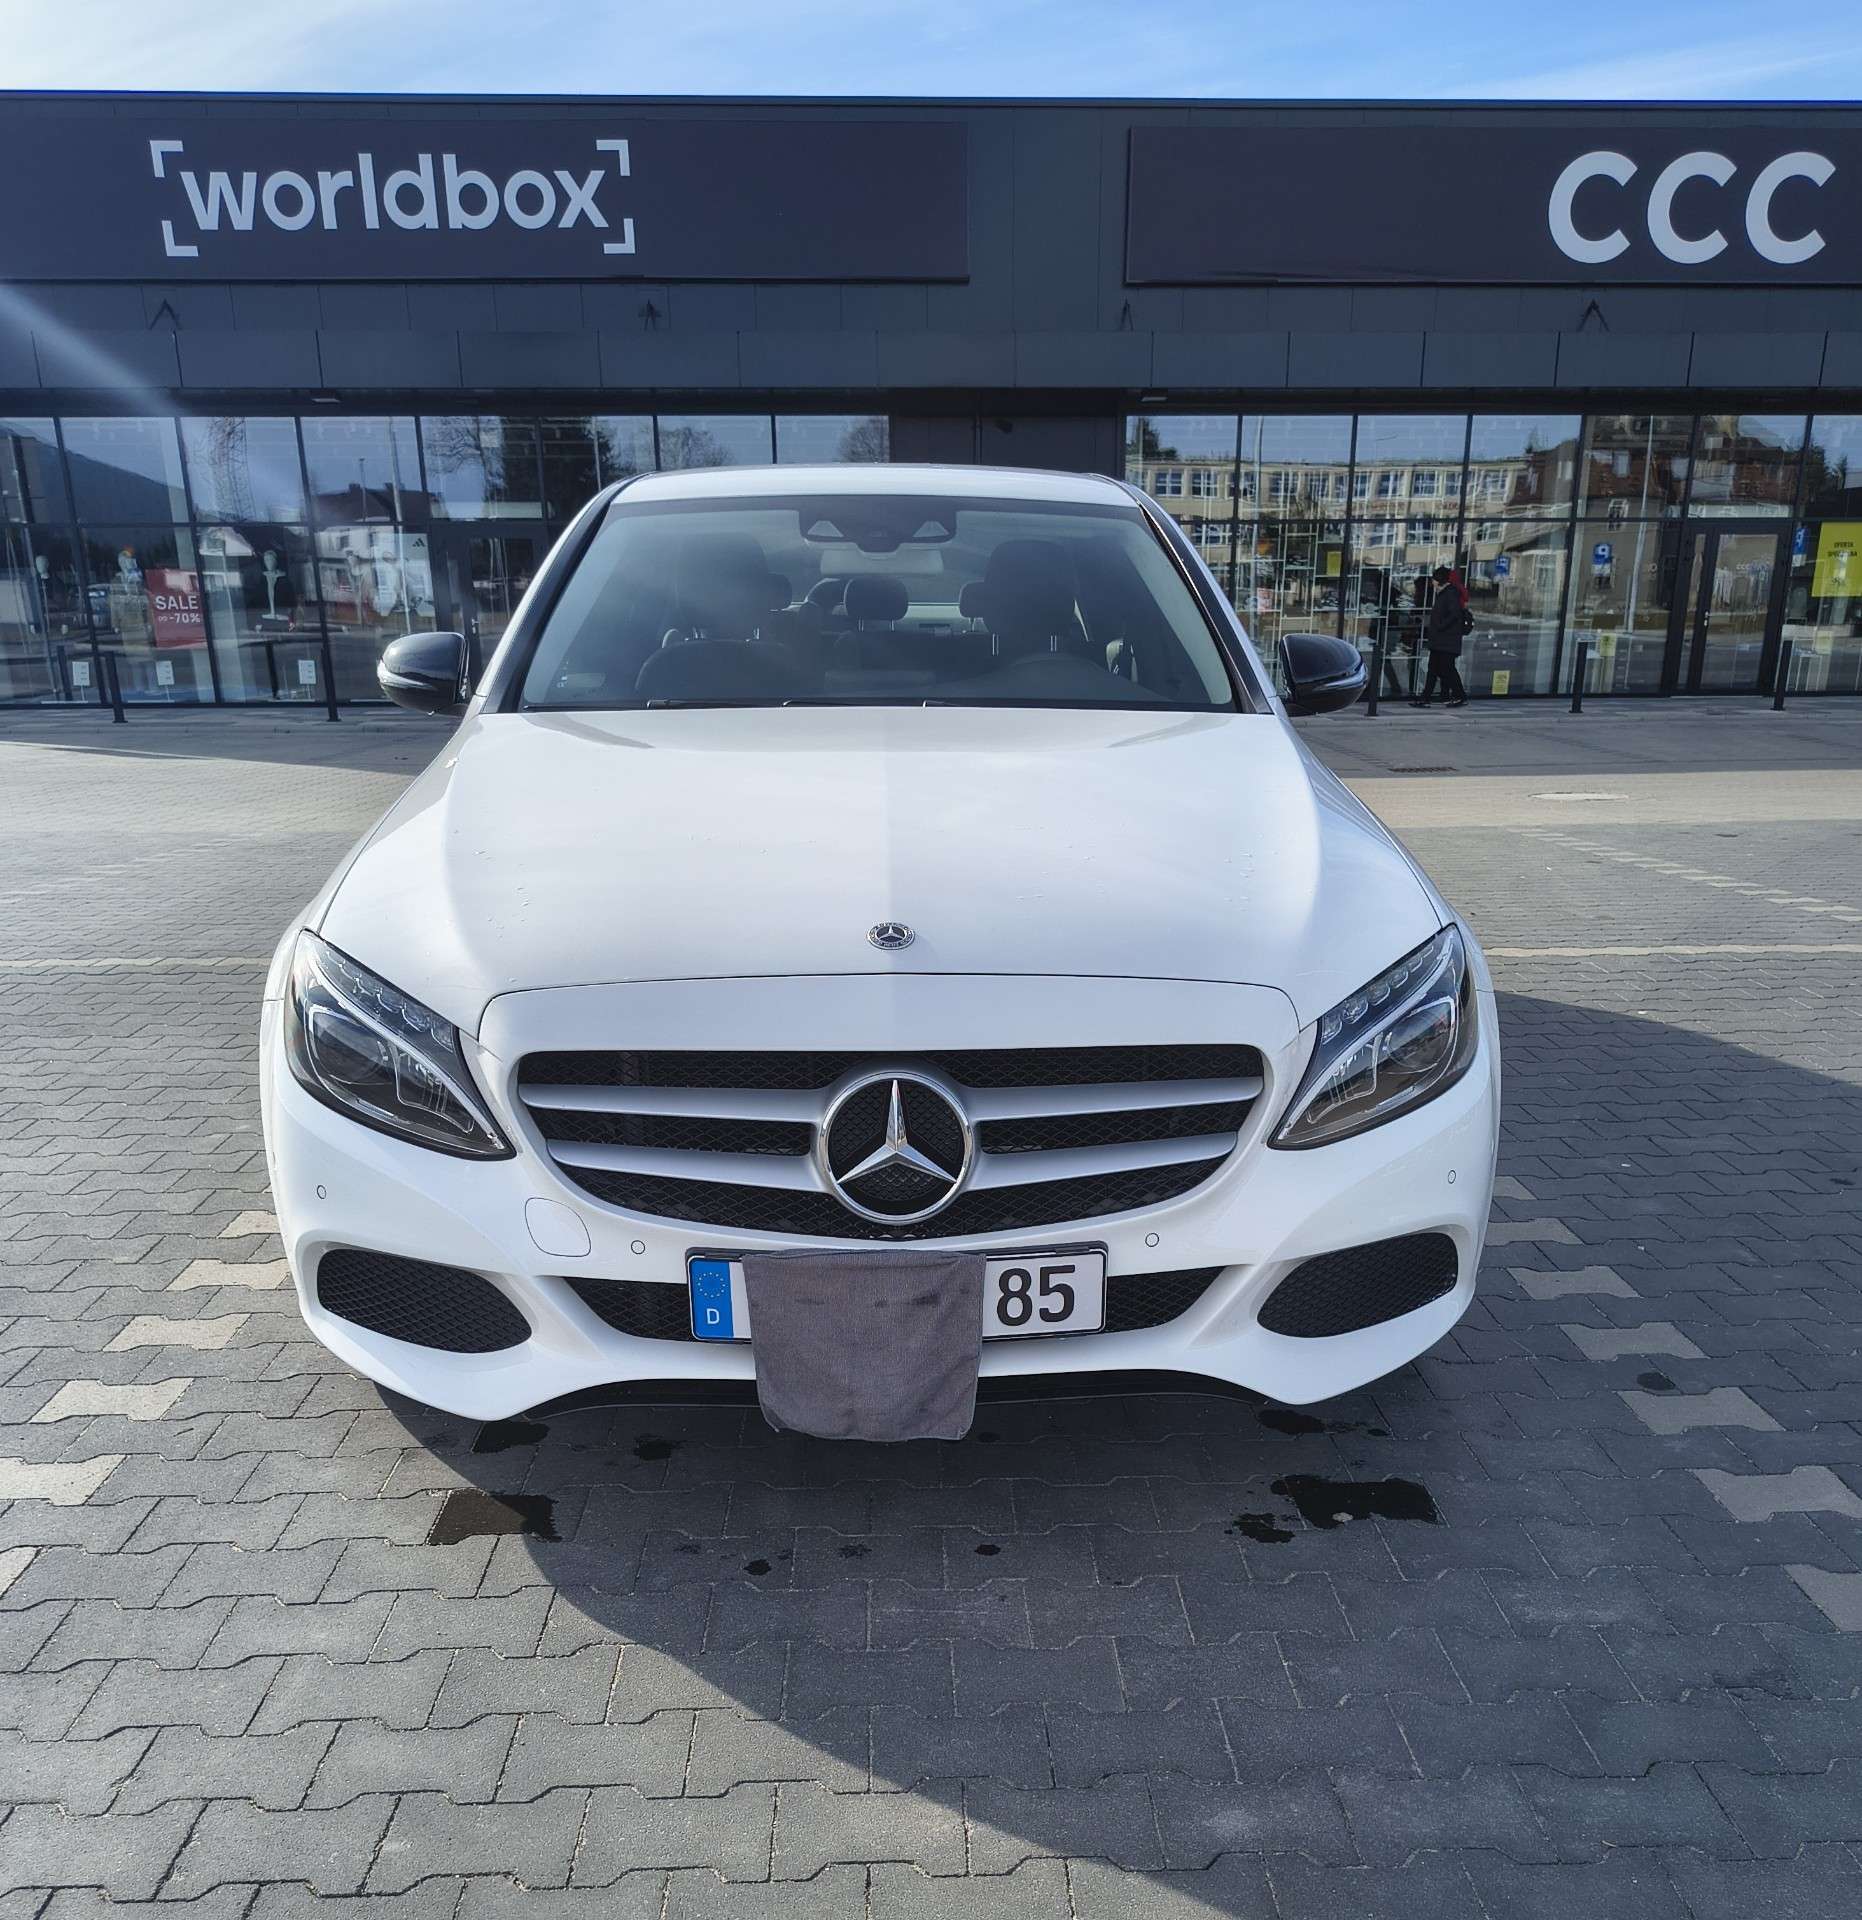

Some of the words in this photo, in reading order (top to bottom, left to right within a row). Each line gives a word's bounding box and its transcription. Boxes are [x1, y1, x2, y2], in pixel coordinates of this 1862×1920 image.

[179, 152, 609, 231] worldbox
[1548, 150, 1837, 264] CCC
[155, 595, 199, 610] SALE
[169, 612, 202, 624] -70%
[706, 1308, 720, 1325] D
[996, 1264, 1076, 1327] 85
